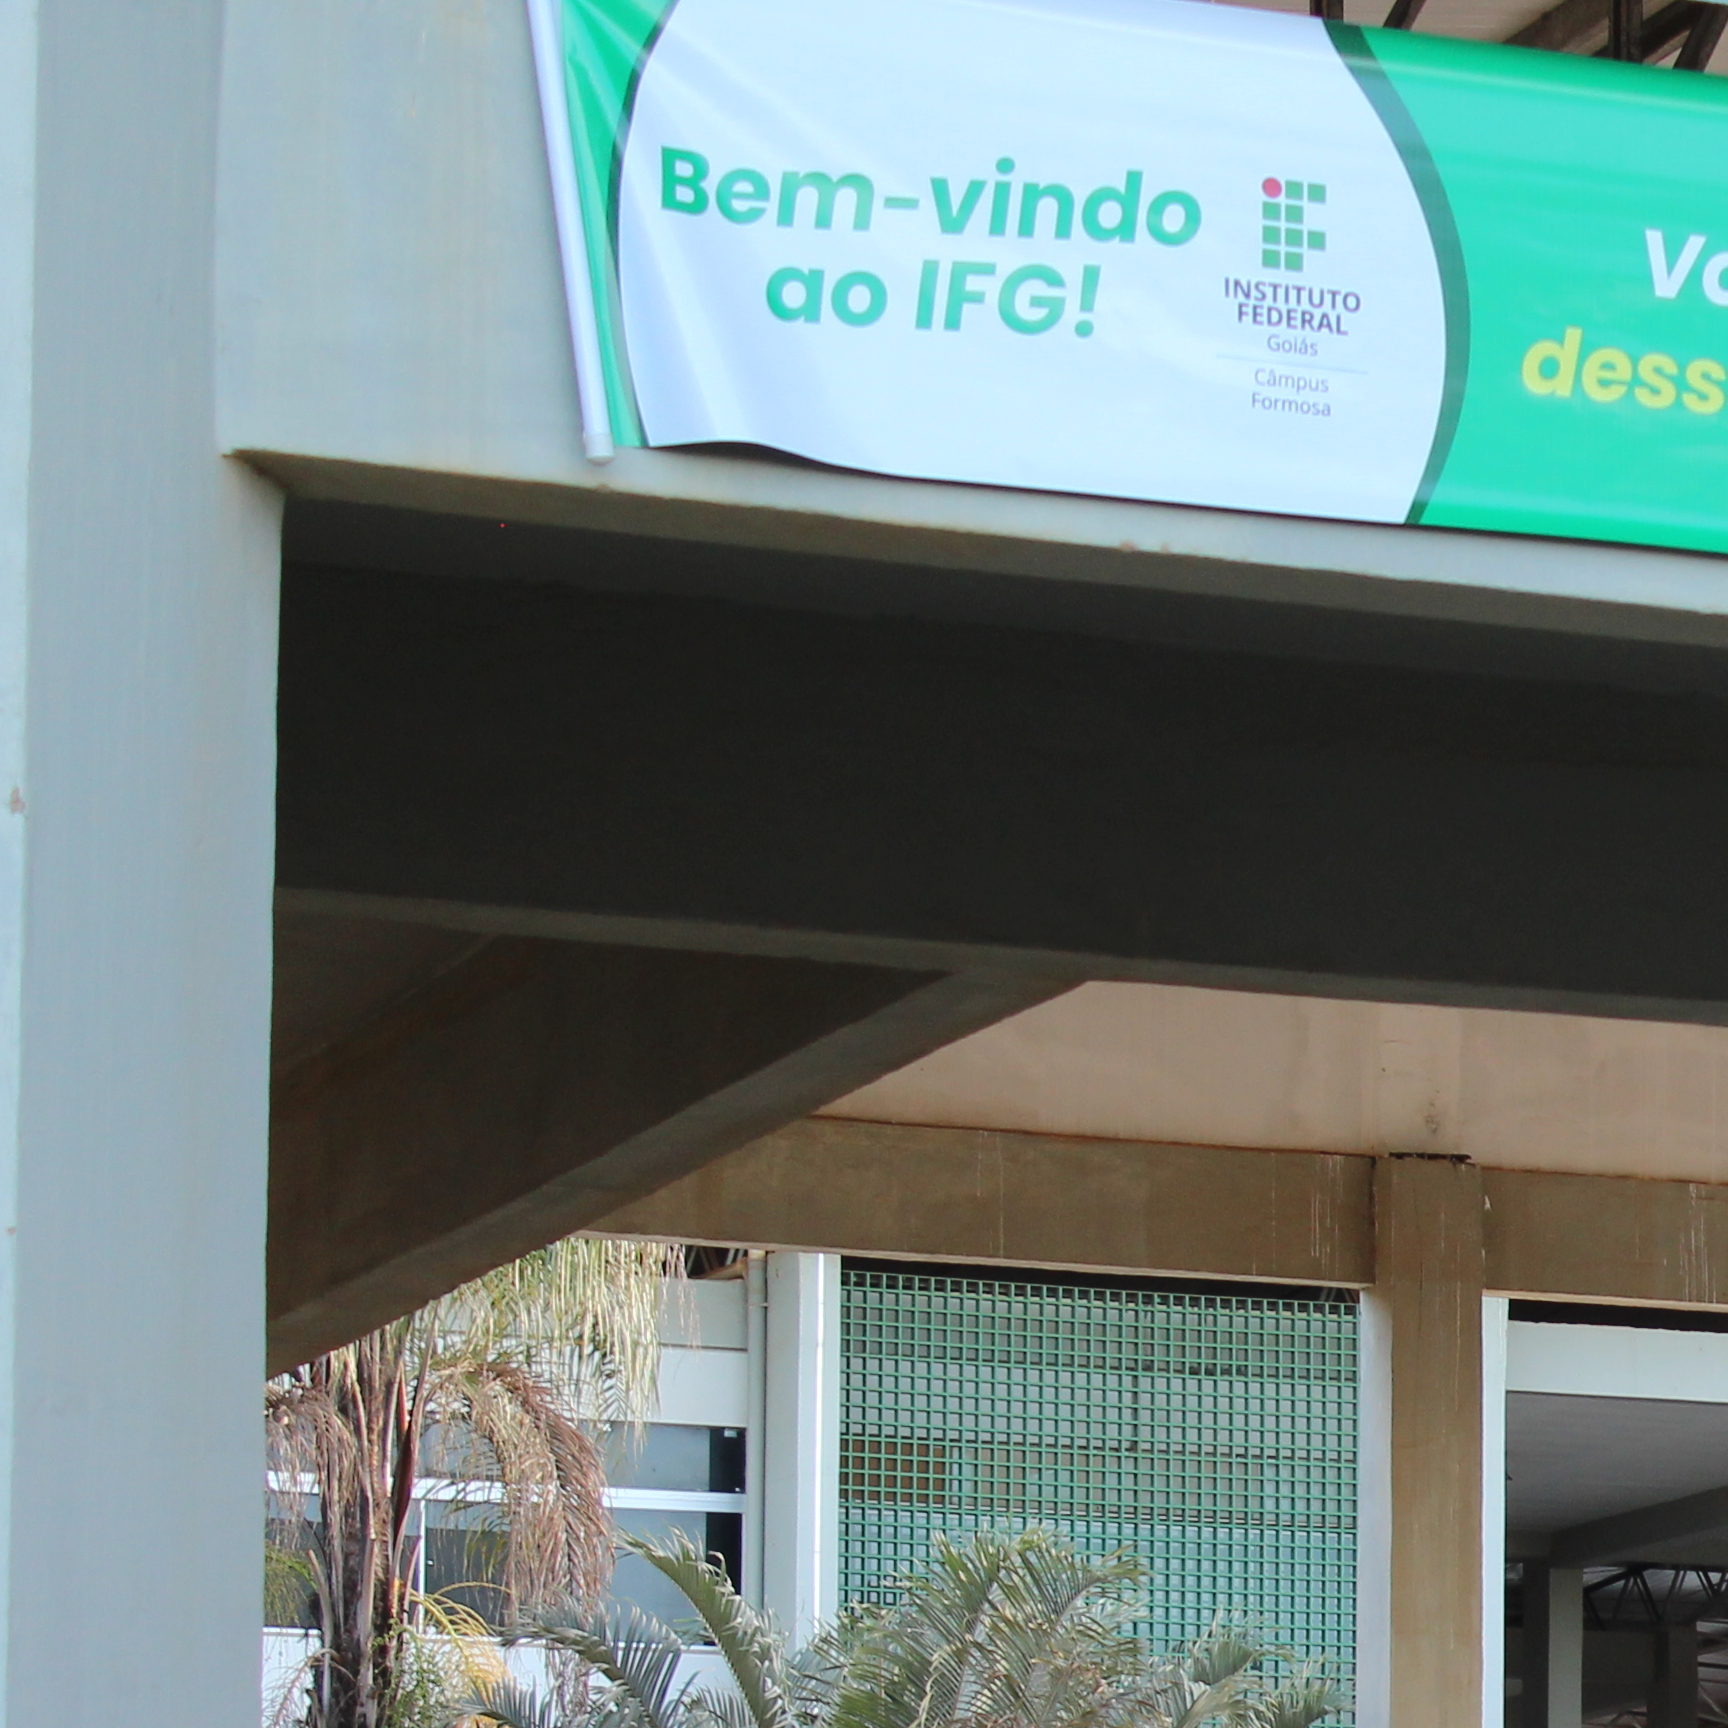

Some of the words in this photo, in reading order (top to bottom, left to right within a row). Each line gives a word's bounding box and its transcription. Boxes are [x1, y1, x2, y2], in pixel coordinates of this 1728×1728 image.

[660, 146, 1201, 247] Bem-vindo
[766, 264, 887, 326] ao
[914, 260, 1102, 338] IFG!
[1224, 277, 1362, 313] INSTITUTO
[1237, 302, 1349, 336] FEDERAL
[1266, 333, 1319, 357] Goiás
[1254, 367, 1330, 394] Câmpus
[1251, 391, 1332, 417] Formosa
